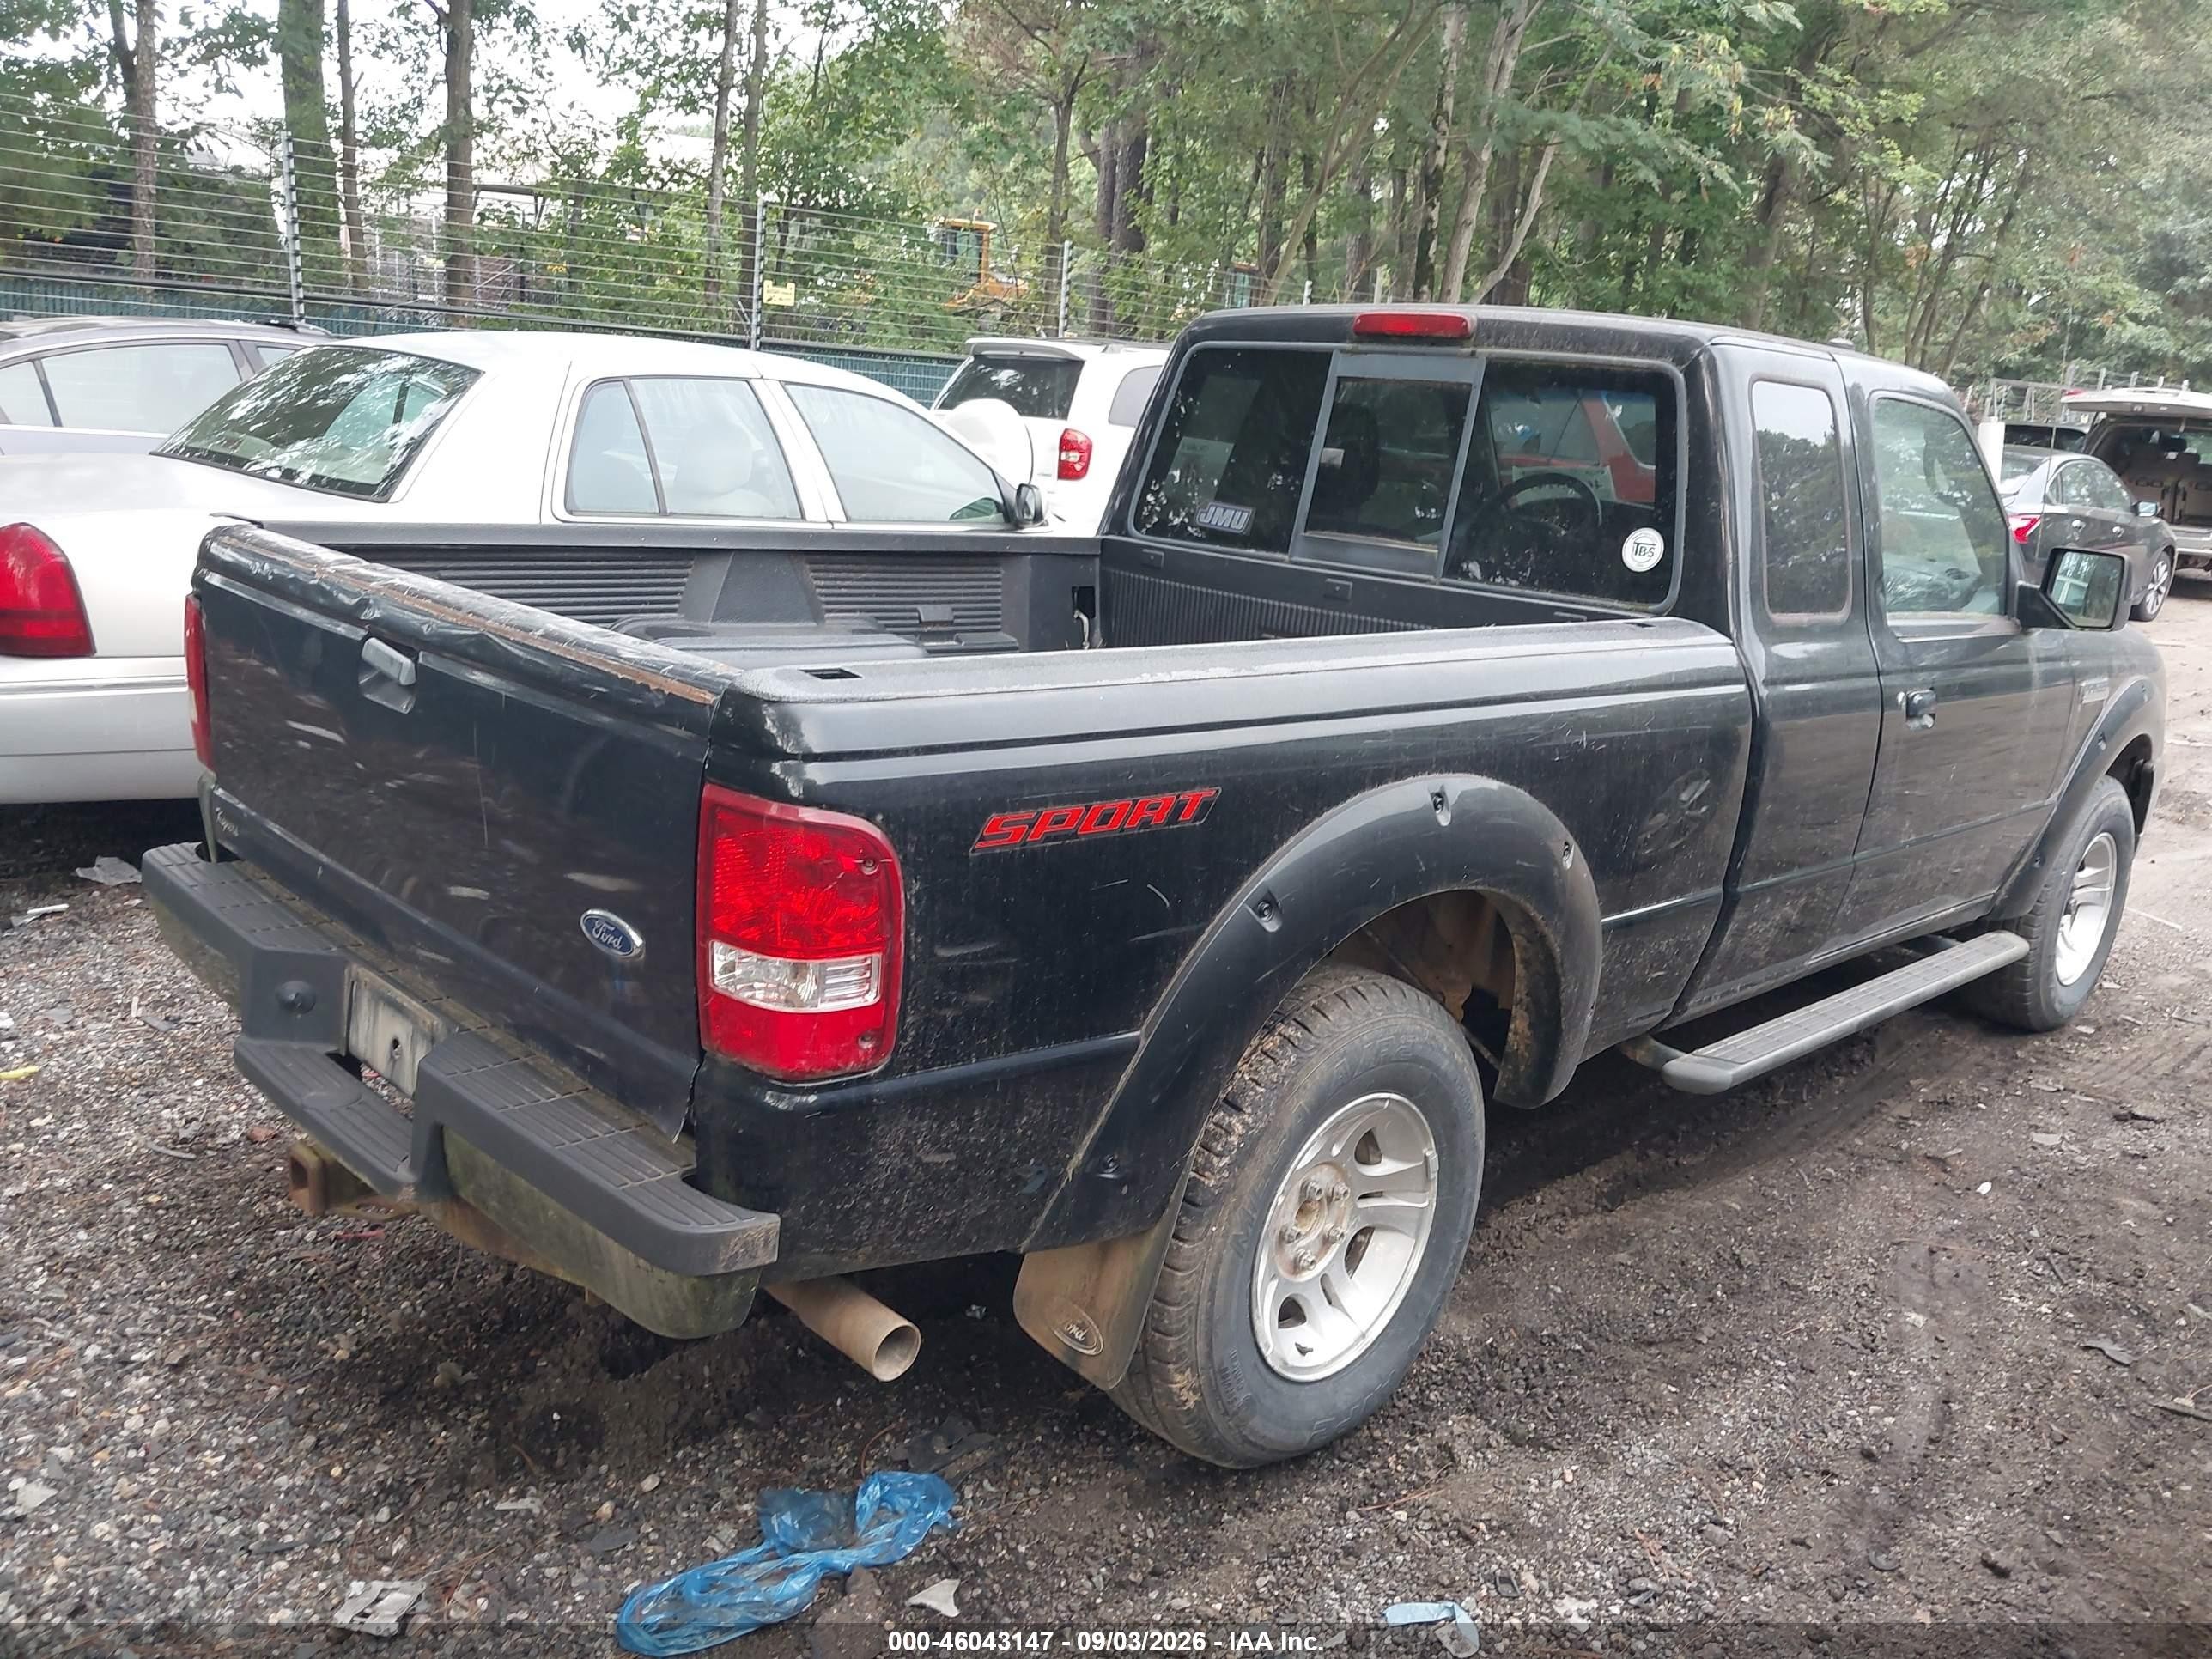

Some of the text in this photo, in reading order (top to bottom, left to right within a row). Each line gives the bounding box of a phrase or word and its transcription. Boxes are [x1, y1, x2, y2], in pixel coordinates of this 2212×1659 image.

[1199, 506, 1249, 530] JMU
[1633, 541, 1656, 557] TBS
[973, 787, 1218, 850] SPORT
[592, 920, 623, 950] Ford
